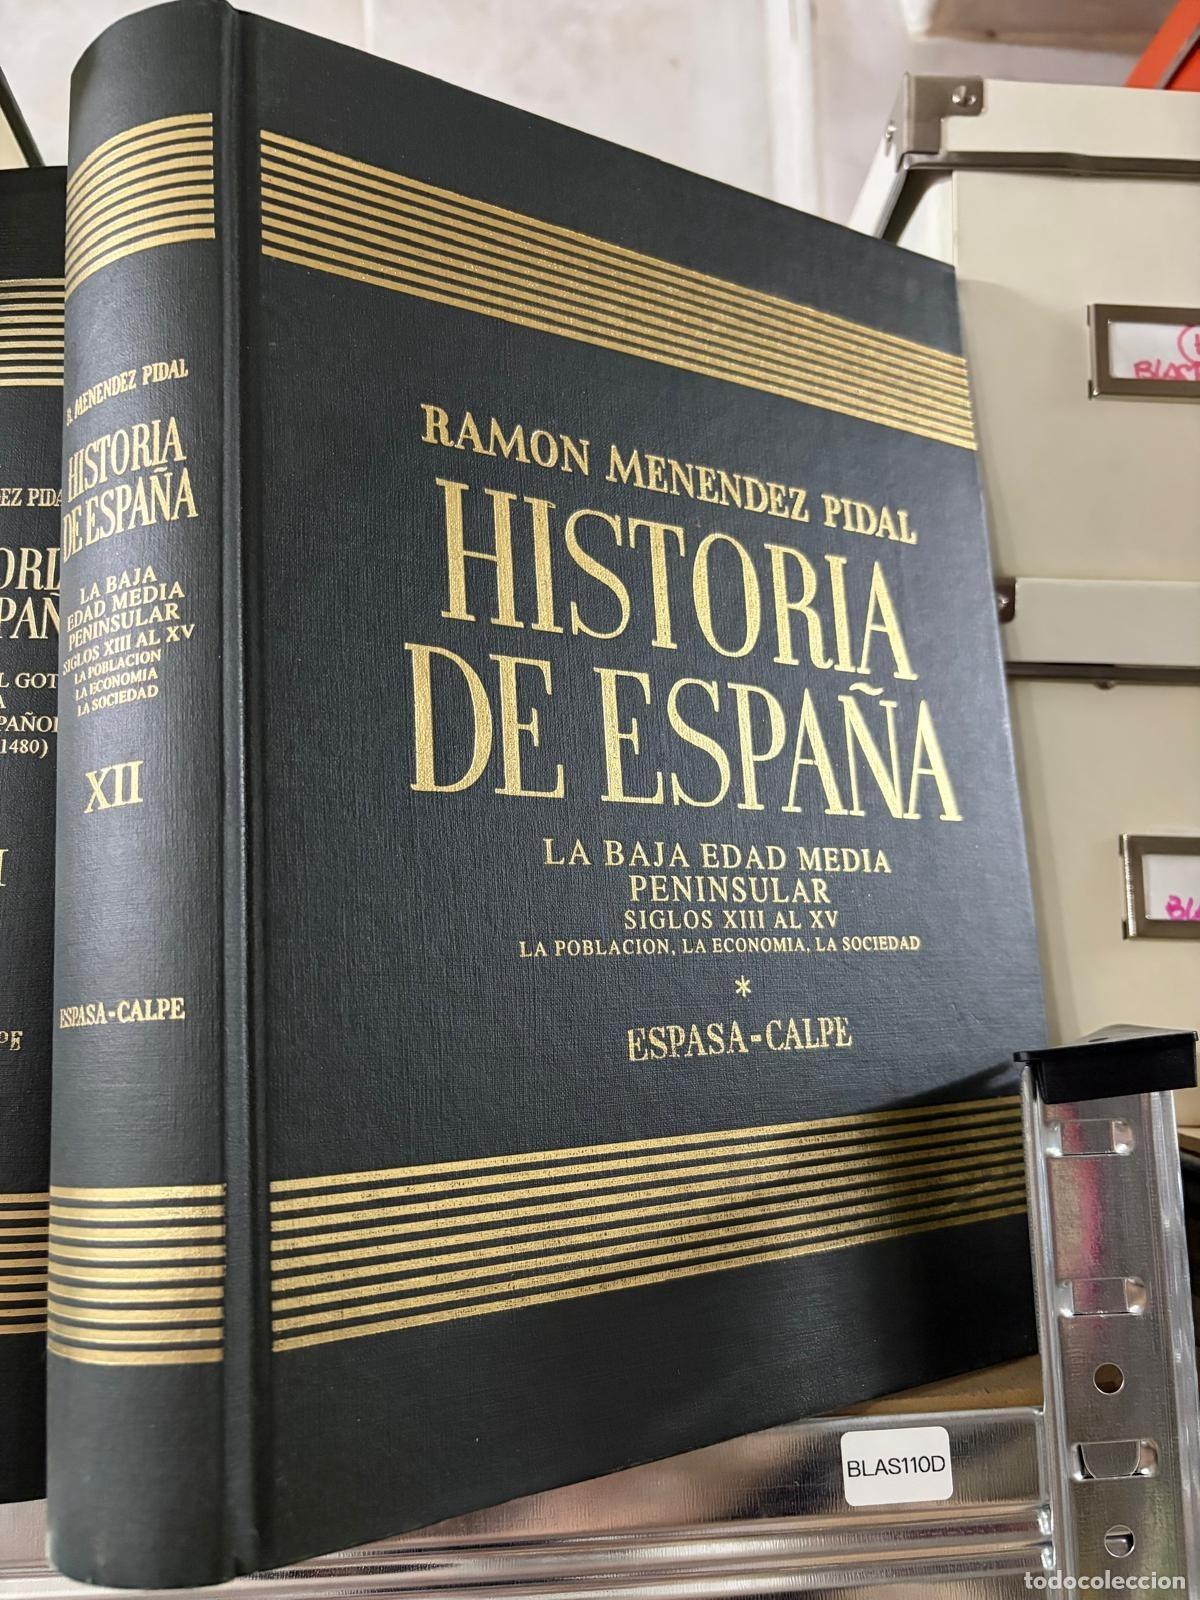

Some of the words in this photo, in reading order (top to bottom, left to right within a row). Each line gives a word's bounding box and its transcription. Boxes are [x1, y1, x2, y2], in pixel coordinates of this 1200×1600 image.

[74, 369, 136, 419] MENENDEZ
[142, 359, 189, 385] PIDAL
[67, 416, 187, 503] HISTORIA
[421, 403, 590, 476] RAMON
[606, 444, 810, 522] MENENDEZ
[821, 493, 918, 544] PIDAL
[63, 506, 83, 564] DE
[85, 466, 199, 545] ESPAÑA
[80, 582, 101, 605] LA
[106, 565, 158, 594] BAJA
[436, 477, 918, 681] HISTORIA
[66, 600, 106, 632] EDAD
[112, 581, 185, 612] MEDIA
[68, 603, 180, 652] PENINSULAR
[62, 645, 100, 676] SIGLOS
[103, 633, 132, 657] XIII
[136, 629, 161, 648] AL
[165, 624, 196, 643] XV
[74, 670, 86, 685] LA
[88, 649, 161, 679] POBLACION
[75, 686, 88, 701] LA
[89, 667, 158, 696] ECONOMIA
[77, 702, 91, 717] LA
[92, 684, 159, 711] SOCIEDAD
[403, 642, 565, 799] DE
[593, 667, 963, 822] ESPAÑA
[84, 760, 144, 814] XII
[543, 838, 592, 866] LA
[604, 840, 690, 868] BAJA
[700, 842, 787, 870] EDAD
[797, 846, 893, 874] MEDIA
[629, 875, 831, 904] PENINSULAR
[624, 910, 714, 931] SIGLOS
[723, 910, 765, 930] XIII
[774, 910, 802, 930] AL
[810, 909, 840, 929] XV
[519, 940, 548, 958] LA
[555, 938, 676, 957] POBLACION,
[682, 937, 707, 954] LA
[712, 936, 810, 954] ECONOMIA,
[815, 936, 838, 952] LA
[842, 935, 921, 952] SOCIEDAD
[59, 997, 186, 1029] ESPASA-CALPE
[627, 1016, 854, 1062] ESPASA-CALPE
[847, 1455, 946, 1478] BLAS110D
